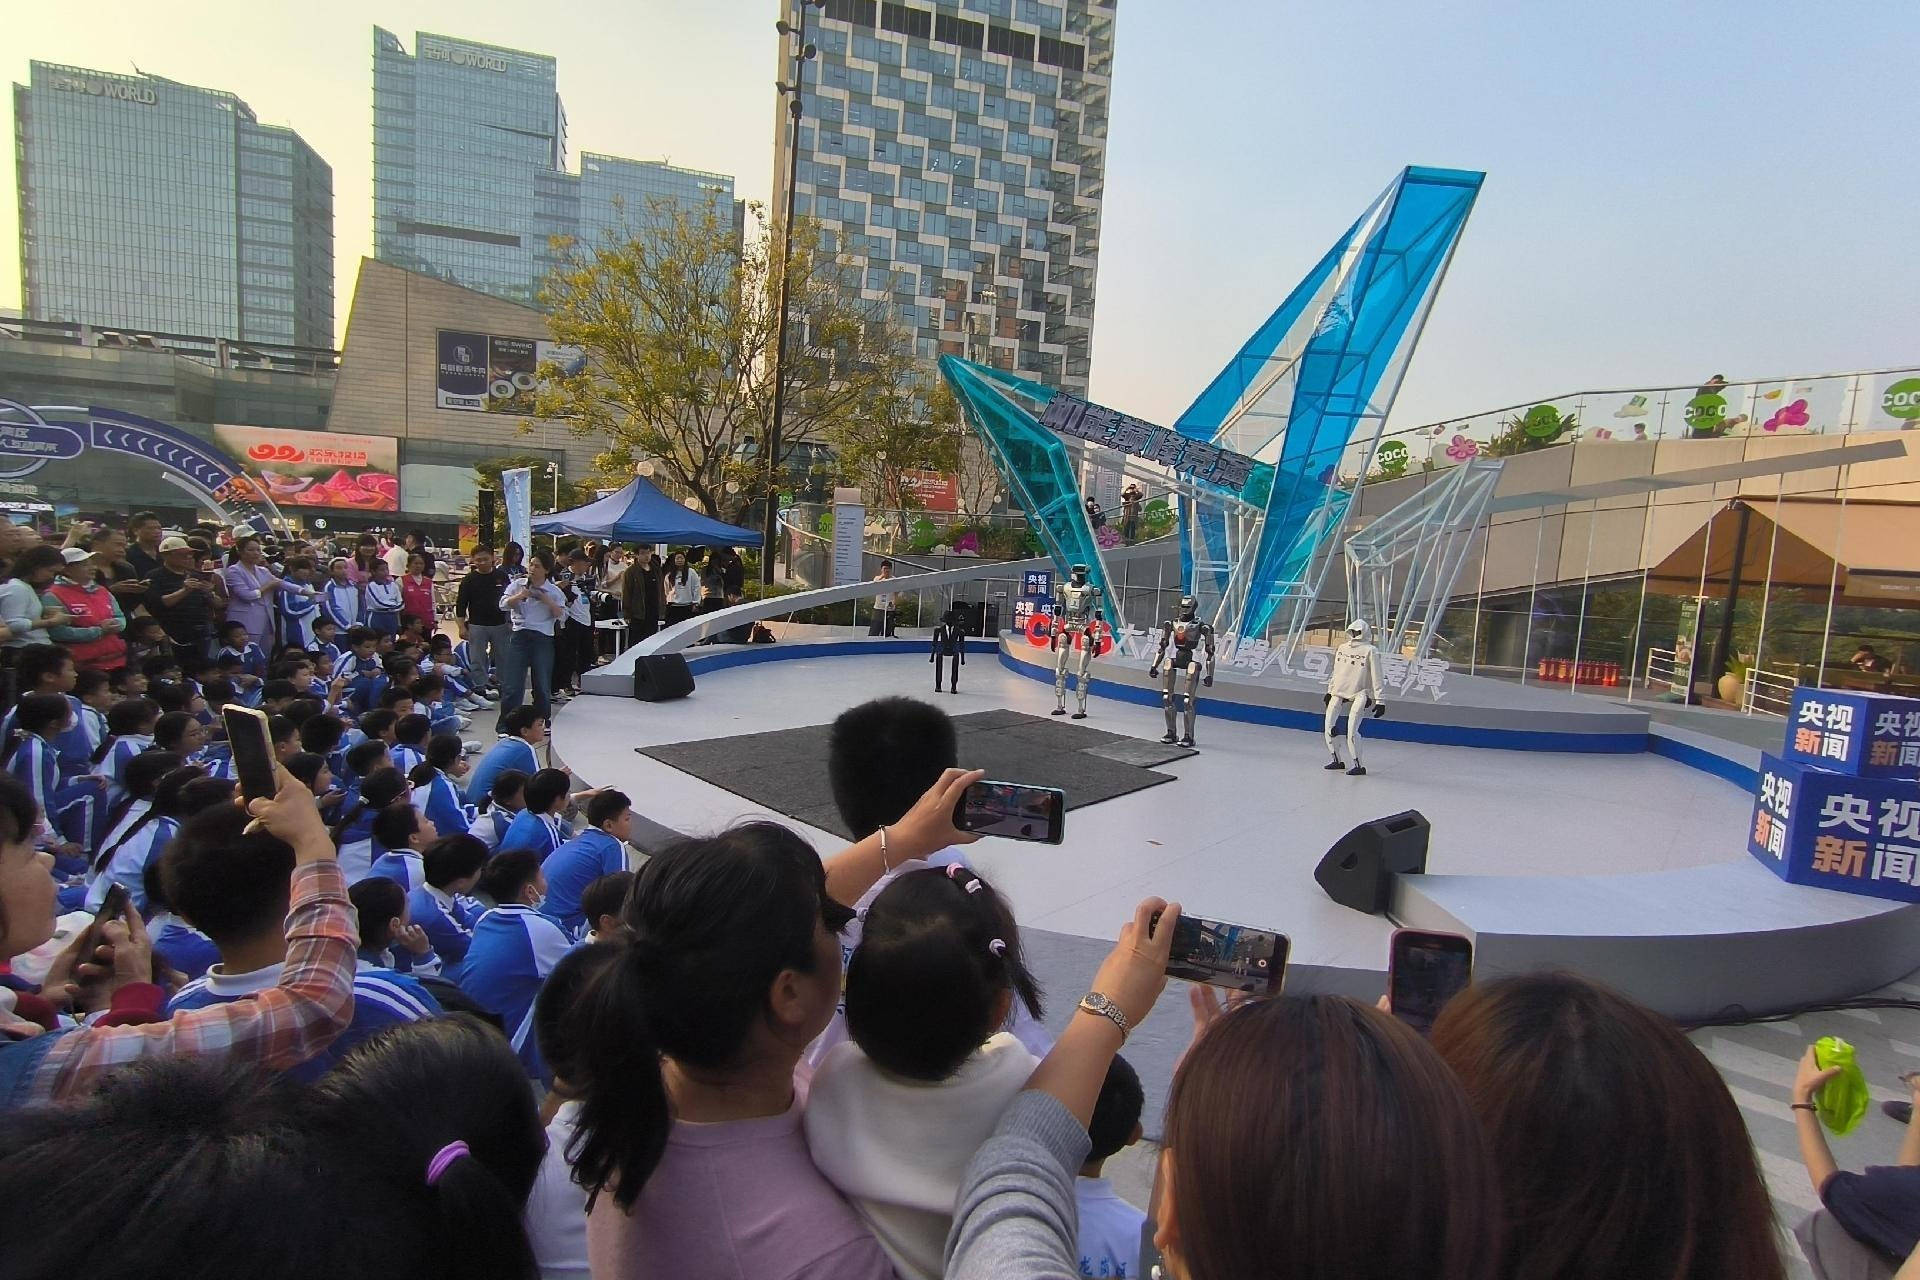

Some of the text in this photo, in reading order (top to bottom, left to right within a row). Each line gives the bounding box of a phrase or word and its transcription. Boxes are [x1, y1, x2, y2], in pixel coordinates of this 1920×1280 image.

[465, 53, 507, 73] WORLD
[103, 80, 156, 105] WORLD
[1376, 447, 1408, 462] COCO
[1028, 574, 1047, 585] 央视
[1015, 601, 1034, 616] 央视
[1798, 700, 1854, 733] 央视
[1874, 711, 1920, 738] 央视
[1793, 727, 1850, 762] 新闻
[1869, 740, 1920, 768] 新闻
[1760, 771, 1793, 820] 央视
[1818, 793, 1920, 841] 央视
[1754, 808, 1787, 861] 新闻
[1811, 834, 1920, 888] 新闻
